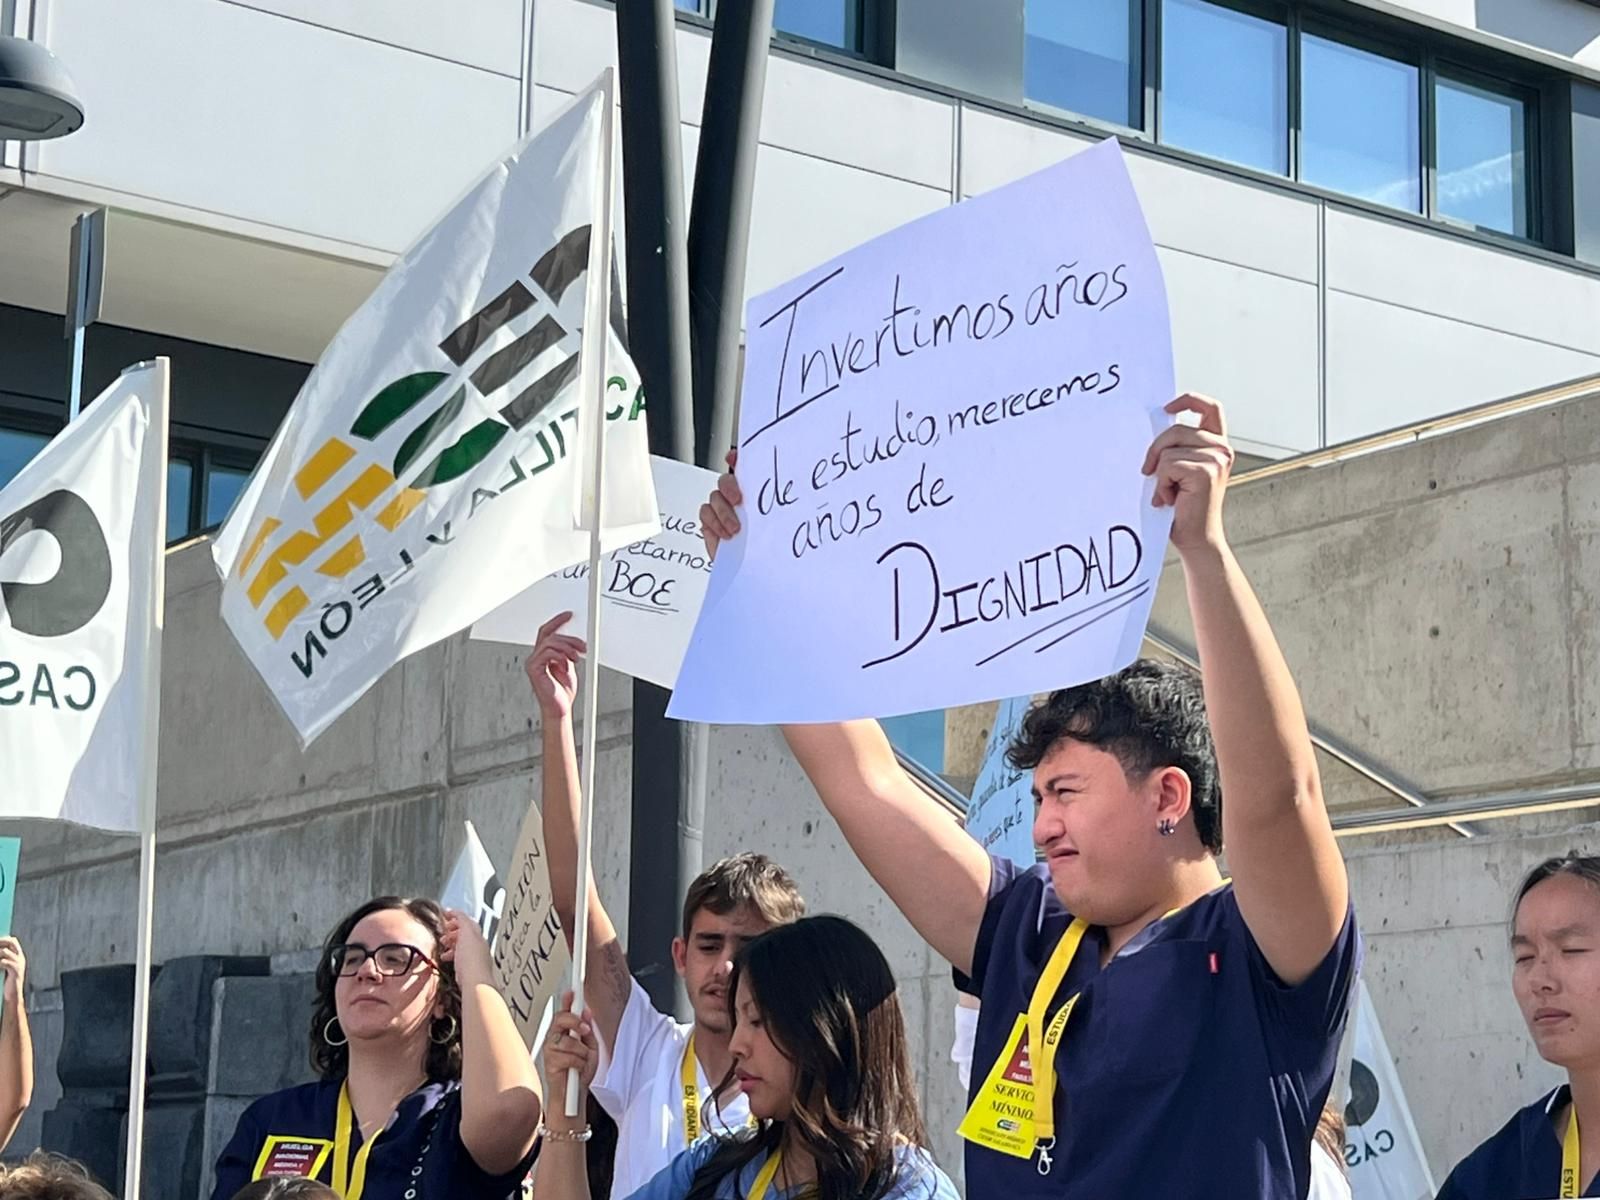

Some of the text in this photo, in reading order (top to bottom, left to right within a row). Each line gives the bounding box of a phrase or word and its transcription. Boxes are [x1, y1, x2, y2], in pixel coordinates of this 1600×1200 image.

[742, 261, 1128, 449] Invertimos años
[757, 446, 798, 516] de
[948, 363, 1121, 431] merecemos
[792, 462, 954, 559] años de
[608, 559, 676, 607] BOE
[861, 525, 1143, 669] DIGNIDAD
[989, 1099, 1034, 1121] MÍNIMO
